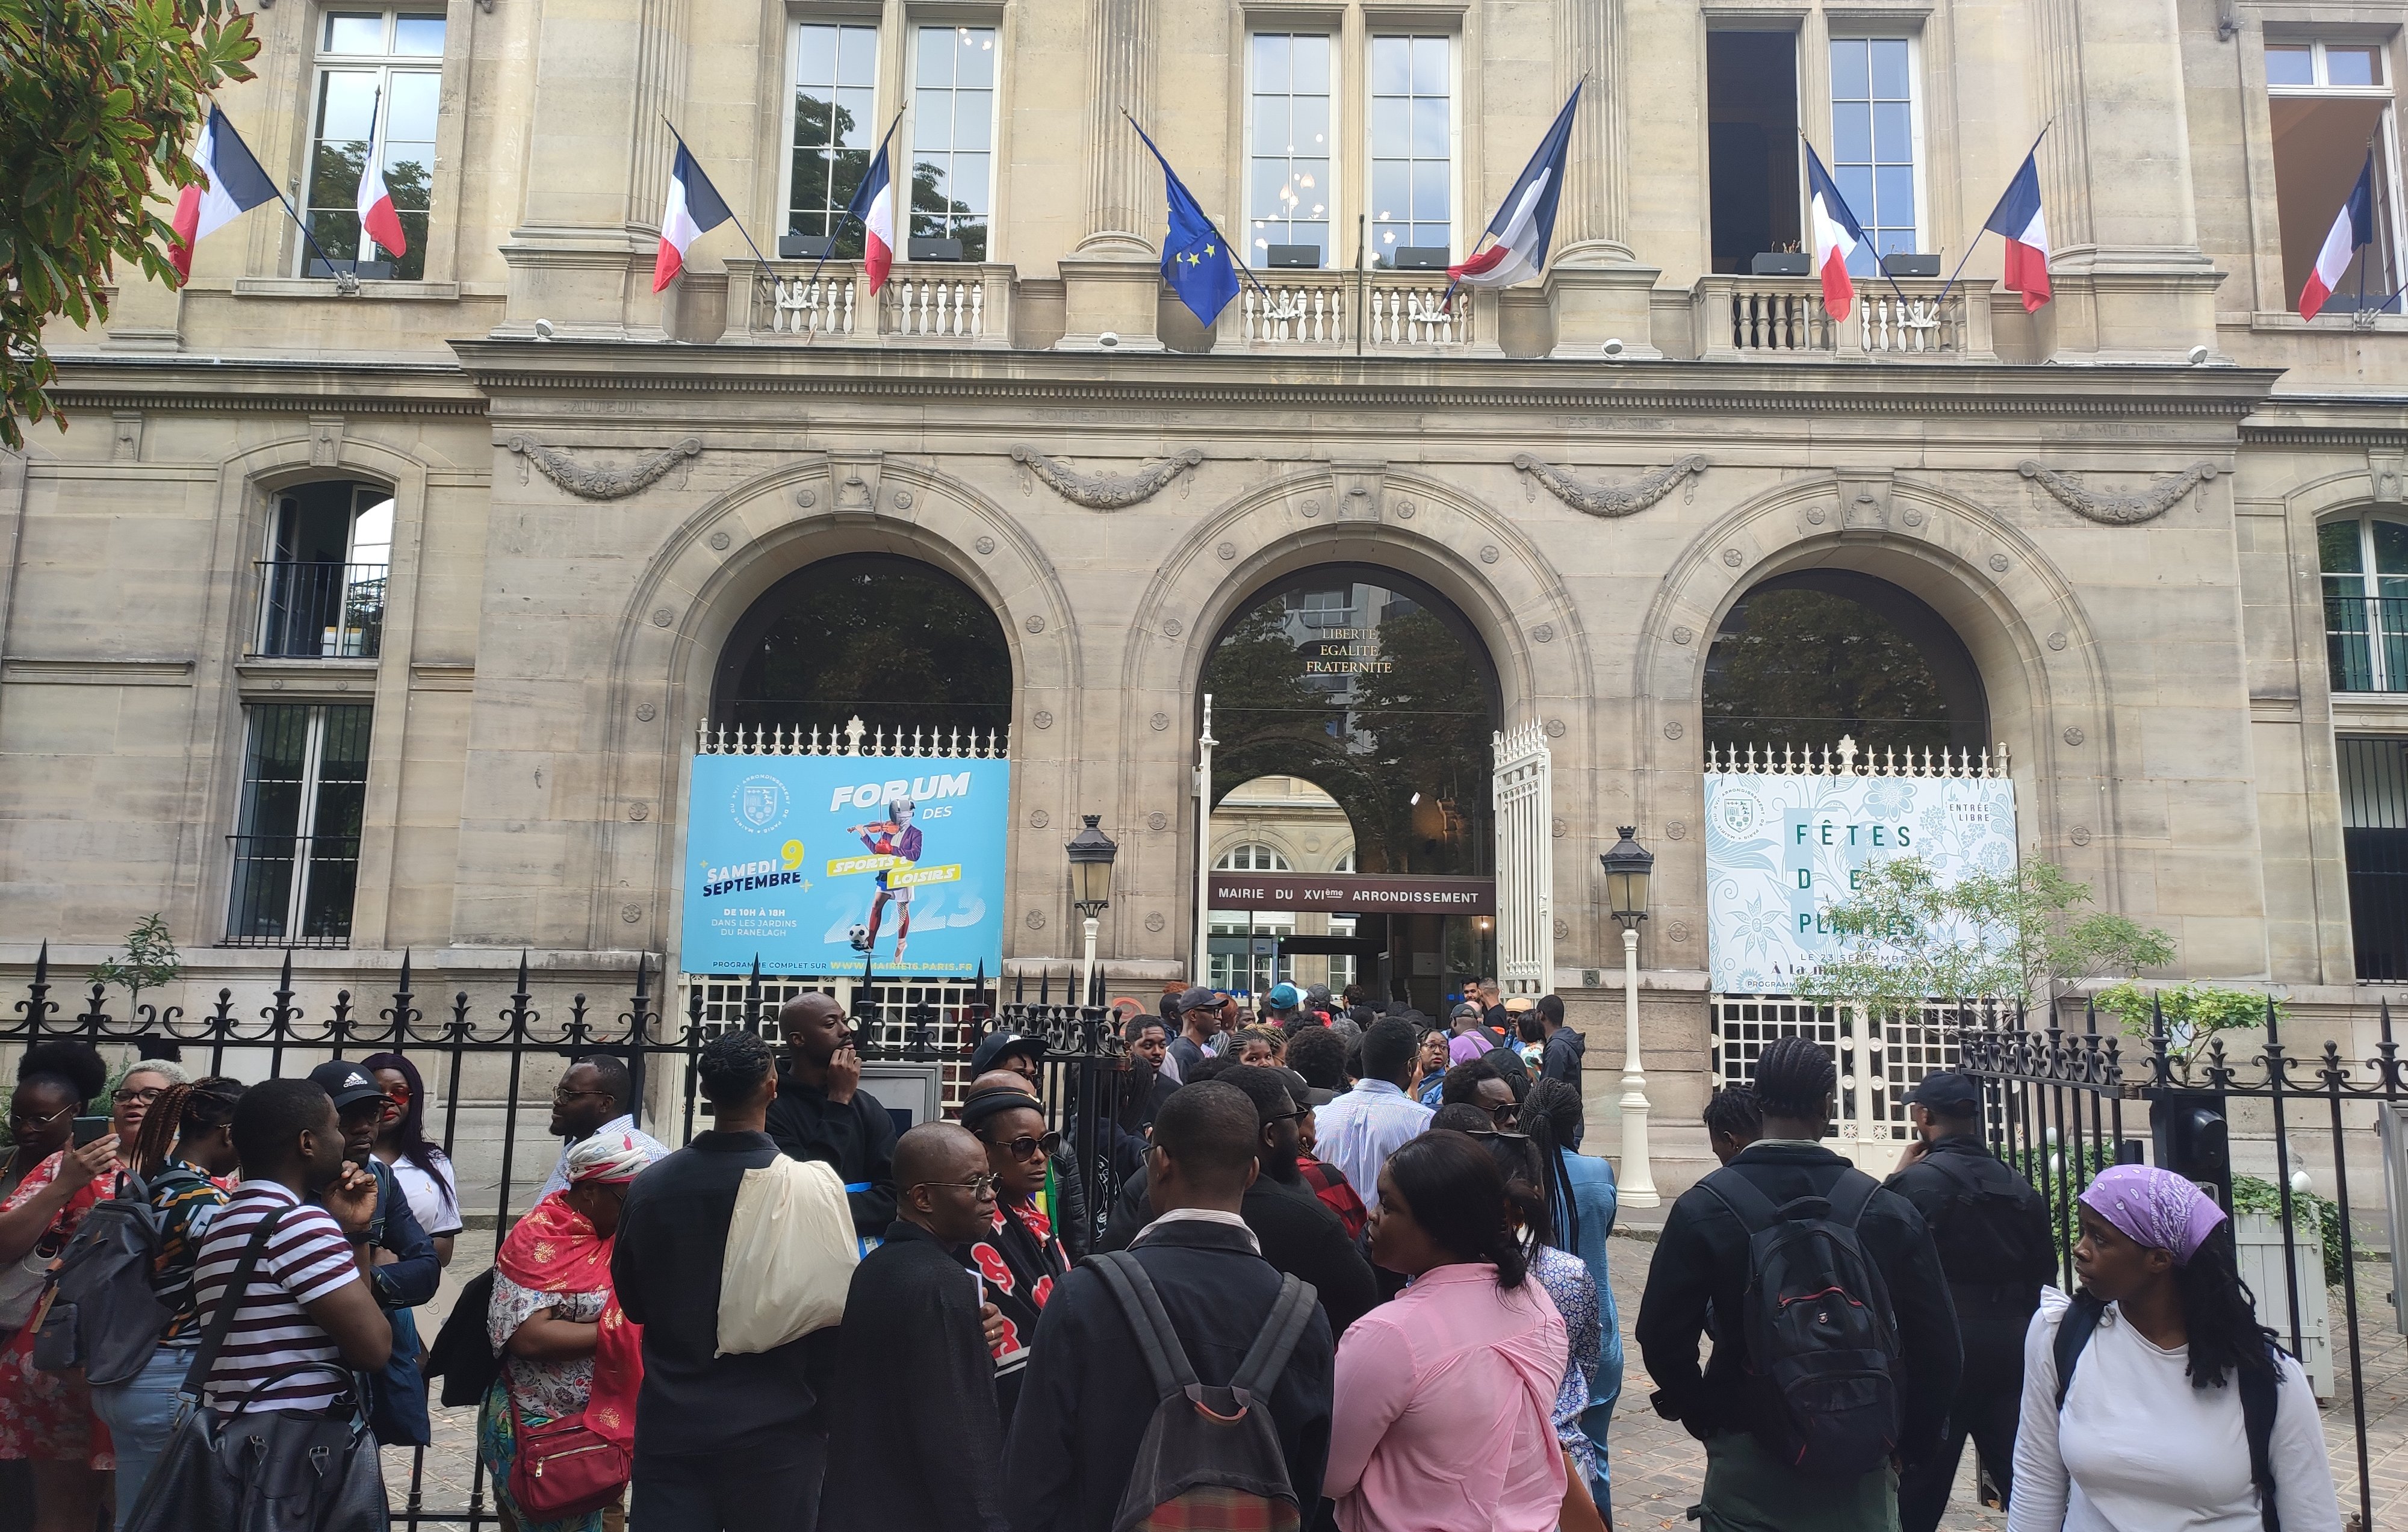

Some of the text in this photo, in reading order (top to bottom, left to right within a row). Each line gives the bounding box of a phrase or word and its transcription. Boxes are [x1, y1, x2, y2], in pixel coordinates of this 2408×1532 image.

[570, 400, 643, 413] AUTEUIL
[1322, 628, 1377, 639] LIBERTE
[1320, 645, 1379, 656] EGALITE
[1306, 662, 1392, 673] FRATERNITE
[830, 772, 971, 812] FORUM
[922, 805, 953, 819] DES
[1950, 802, 1989, 811] ENTRÉE
[1796, 819, 1910, 847] FÊTES
[707, 839, 804, 883] SAMEDI 9
[833, 856, 896, 873] SPORTS
[893, 868, 955, 885] LOISIRS
[703, 872, 801, 897] SEPTEMBRE
[1218, 888, 1264, 898] MAIRIE
[1276, 889, 1293, 899] DU
[1353, 890, 1479, 903] ARRONDISSEMENT
[759, 907, 766, 916] À
[1770, 961, 1781, 974] À
[1790, 964, 1805, 975] la
[343, 1079, 368, 1088] adidas
